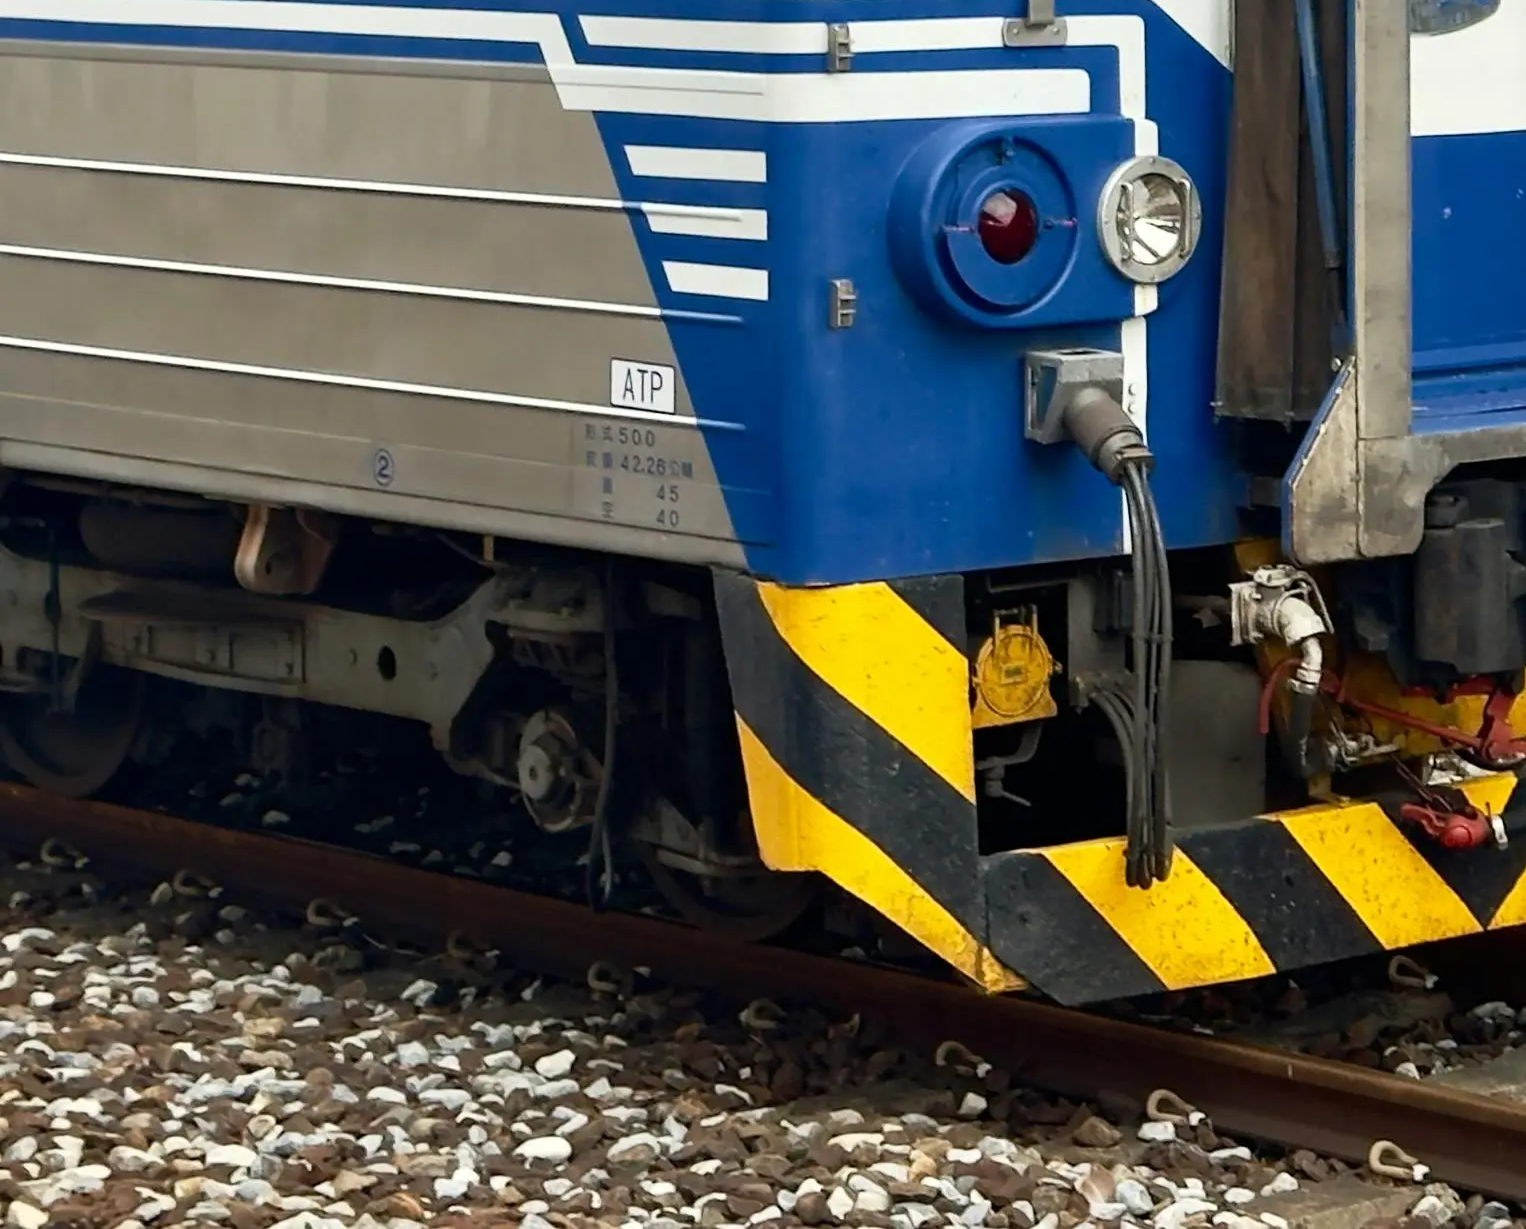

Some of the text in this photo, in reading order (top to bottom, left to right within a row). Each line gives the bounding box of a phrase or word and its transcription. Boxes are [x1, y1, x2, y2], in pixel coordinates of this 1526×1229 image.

[622, 366, 664, 404] ATP
[618, 426, 656, 448] 500
[620, 454, 667, 476] 42.26
[655, 484, 680, 504] 45
[655, 509, 680, 528] 40
